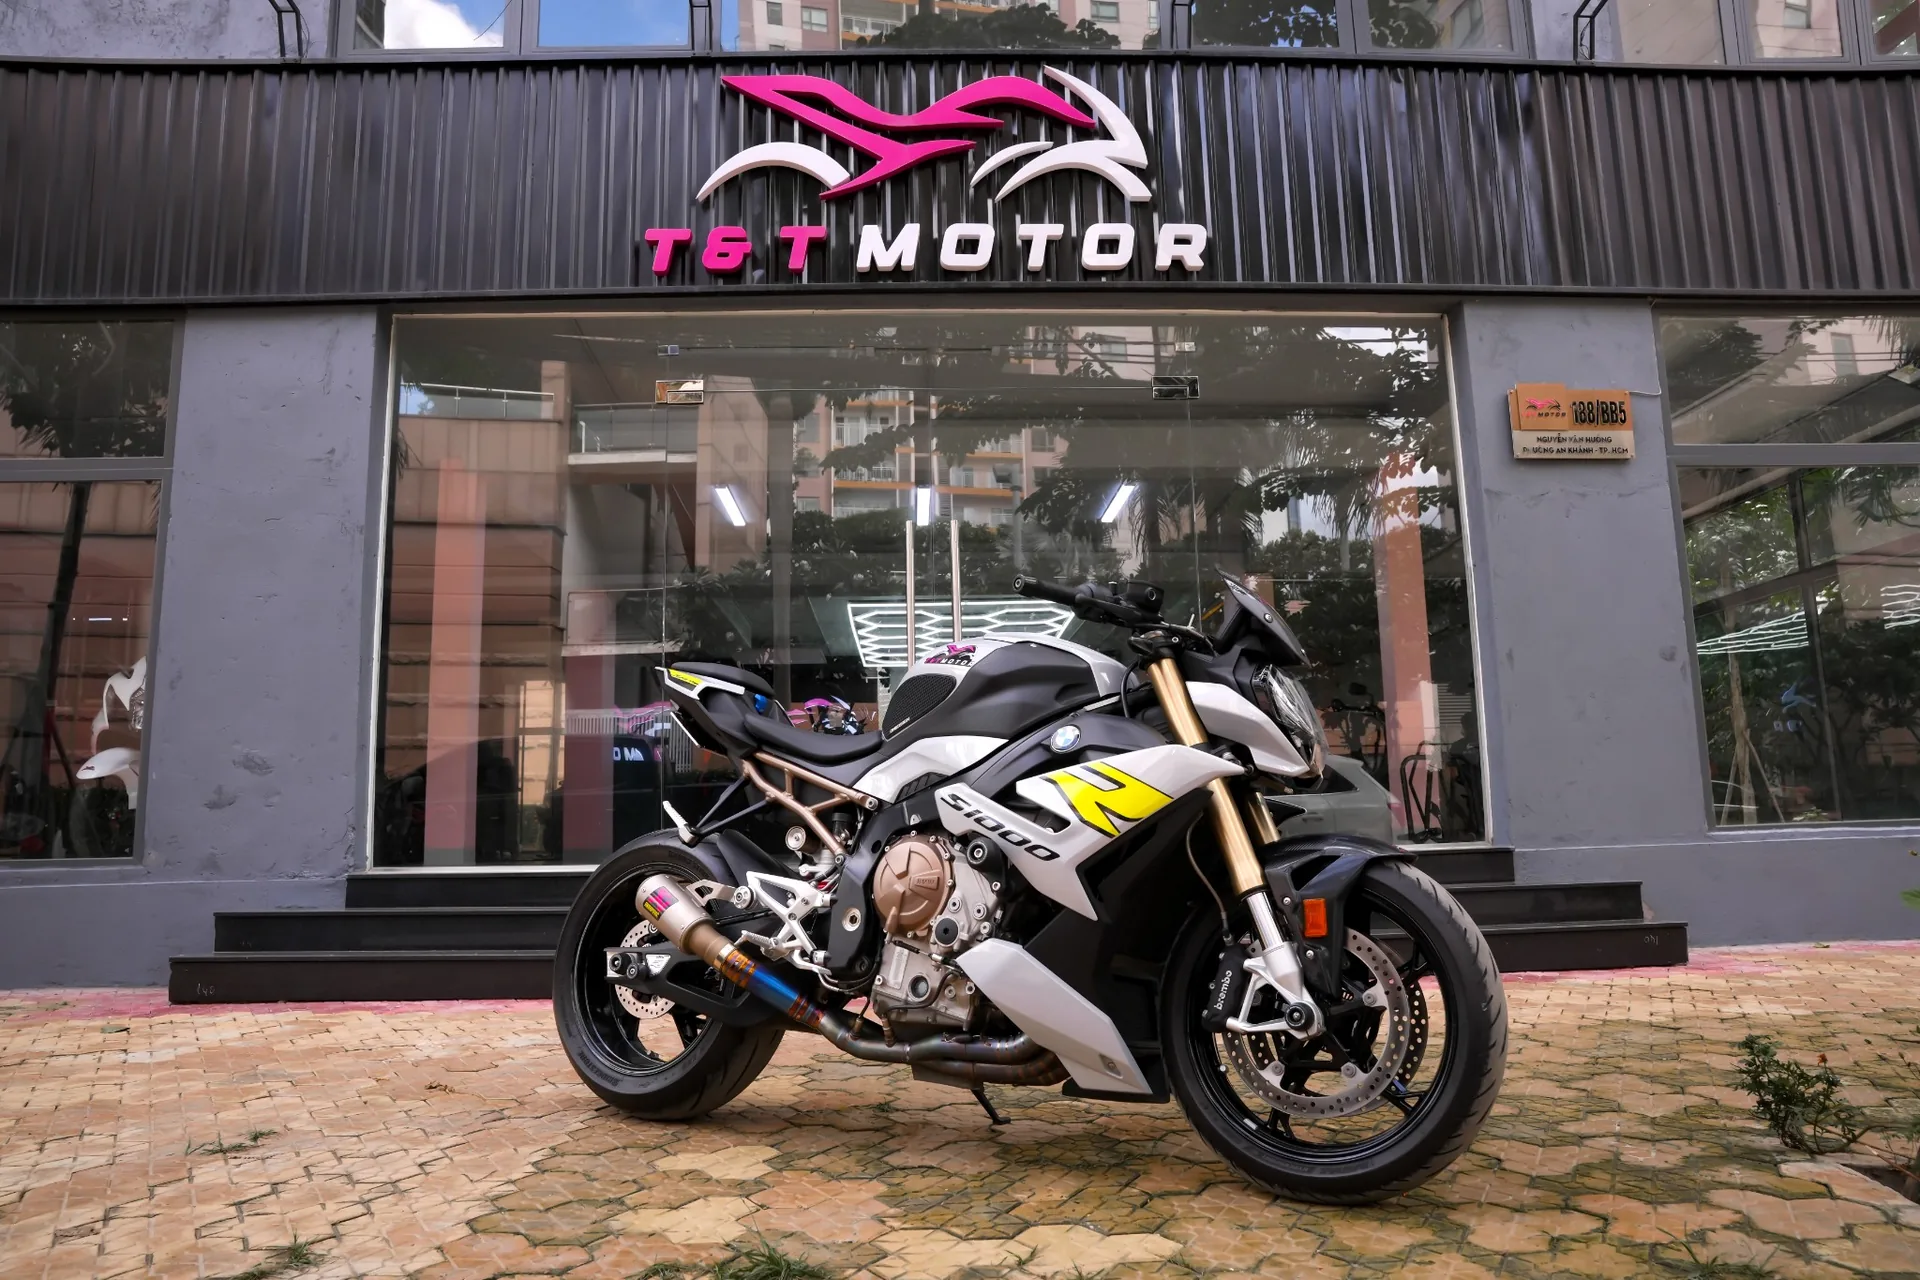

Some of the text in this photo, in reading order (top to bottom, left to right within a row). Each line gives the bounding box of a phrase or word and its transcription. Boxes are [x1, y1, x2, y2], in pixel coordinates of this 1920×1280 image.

[856, 222, 1208, 272] MOTOR
[1570, 400, 1627, 426] 188/BB5
[1555, 446, 1567, 454] AN
[940, 793, 1060, 861] S1000
[1213, 970, 1233, 1010] brembo
